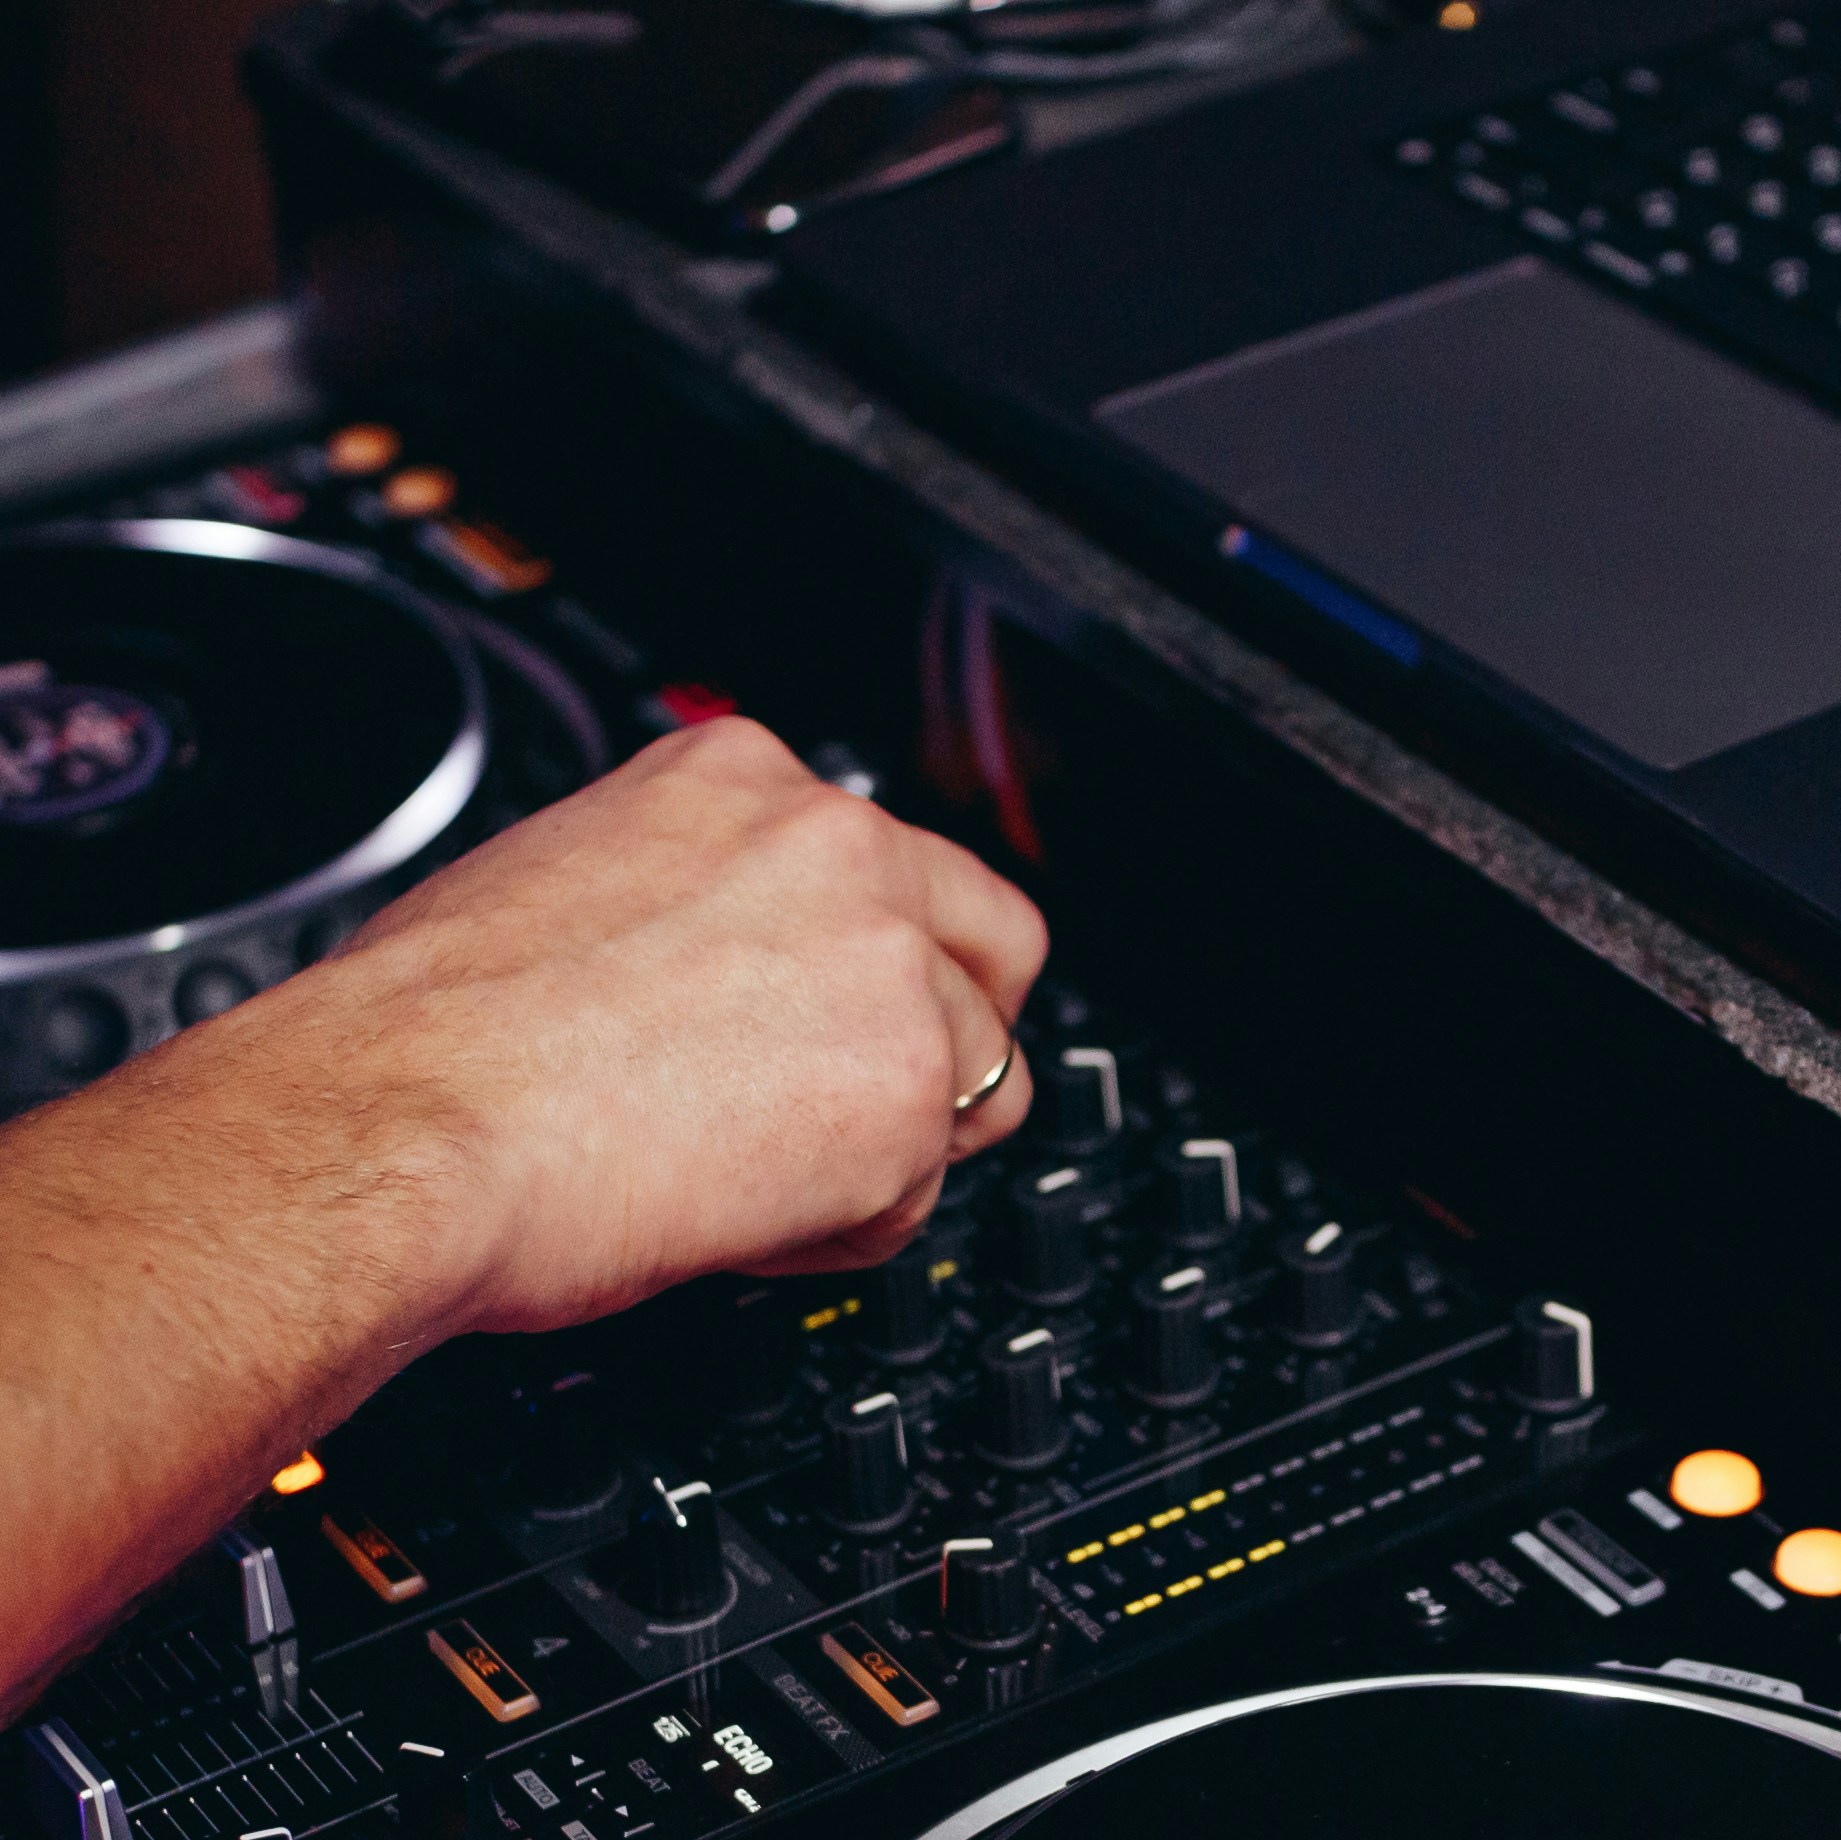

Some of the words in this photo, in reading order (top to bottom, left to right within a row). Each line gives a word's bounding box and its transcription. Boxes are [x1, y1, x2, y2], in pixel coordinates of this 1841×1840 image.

[531, 1637, 570, 1660] 4
[814, 1714, 850, 1740] FX
[712, 1724, 774, 1775] ECHO
[519, 1775, 555, 1806] AUTO
[627, 1758, 672, 1793] BEAT
